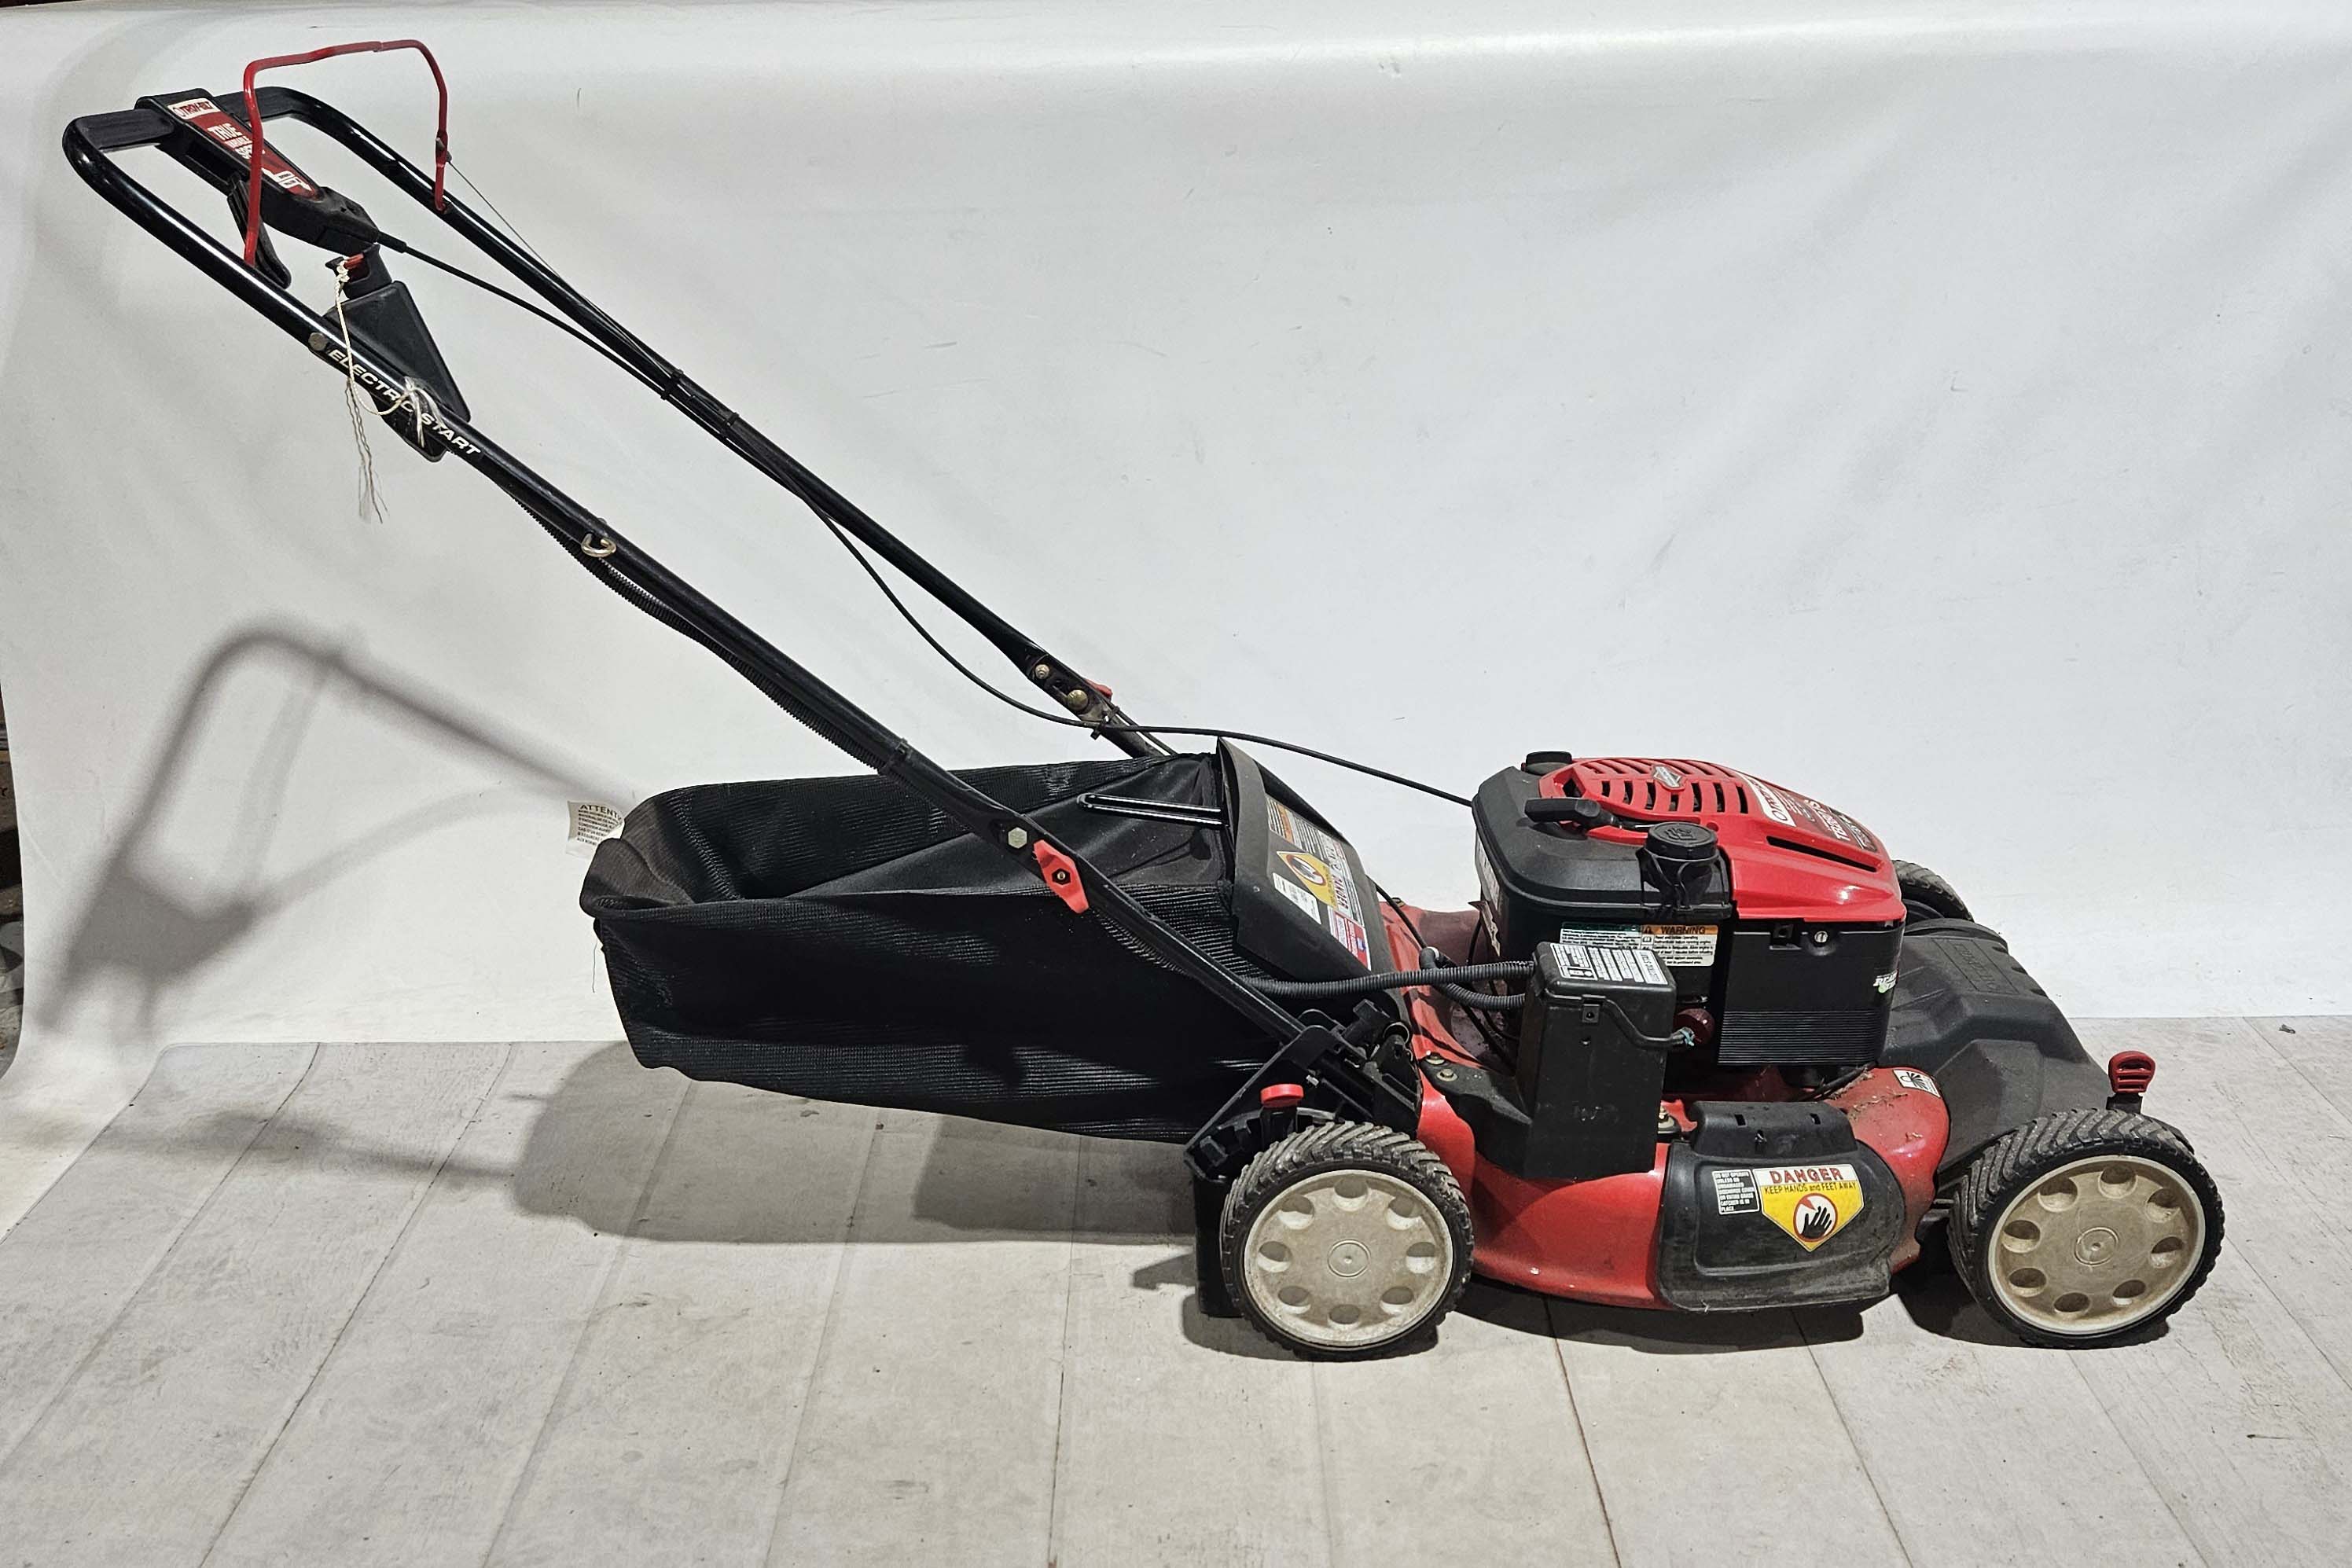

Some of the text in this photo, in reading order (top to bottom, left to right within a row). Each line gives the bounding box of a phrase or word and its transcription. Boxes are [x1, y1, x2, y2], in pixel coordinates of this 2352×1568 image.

[207, 123, 243, 141] TRUE
[328, 349, 417, 413] ELECTRC
[1660, 925, 1706, 935] WARNING
[1769, 1167, 1844, 1184] DANGER
[1764, 1185, 1784, 1195] KEEP
[1784, 1183, 1809, 1193] HANDS
[1821, 1181, 1838, 1192] FEET
[1839, 1181, 1858, 1190] AWAY
